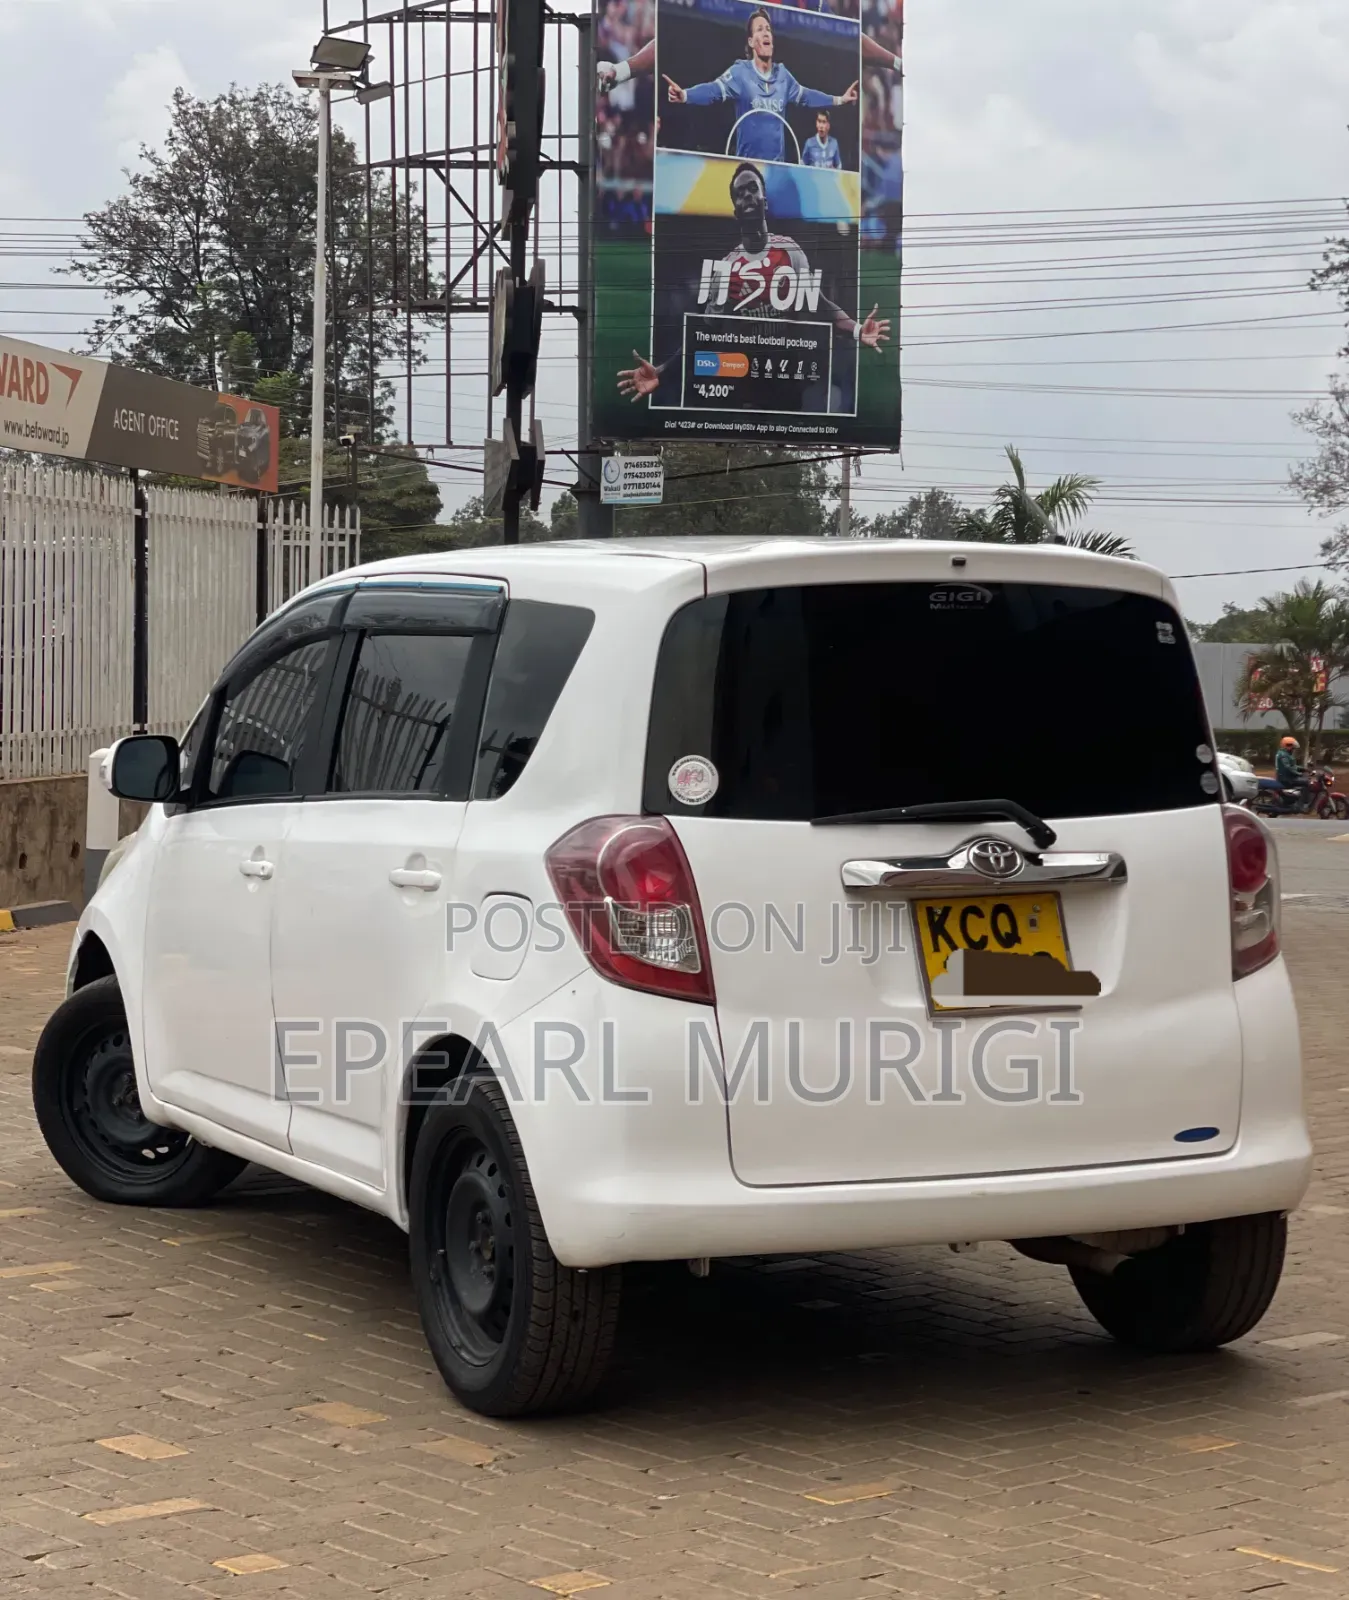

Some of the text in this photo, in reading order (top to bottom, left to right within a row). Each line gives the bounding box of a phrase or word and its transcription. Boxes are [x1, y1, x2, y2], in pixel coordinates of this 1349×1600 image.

[697, 257, 823, 312] IT'S ON
[695, 331, 818, 350] The world's best football package
[696, 359, 746, 370] DStv Compact
[698, 384, 729, 399] 4,200
[113, 408, 180, 441] AGENT OFFICE
[704, 422, 734, 430] Download
[756, 424, 768, 433] App
[768, 424, 775, 432] to
[775, 425, 788, 434] stay
[788, 425, 818, 434] Connected
[819, 426, 825, 434] to
[825, 426, 839, 434] DStv
[928, 591, 982, 602] GIGI
[925, 903, 1022, 953] KCQ
